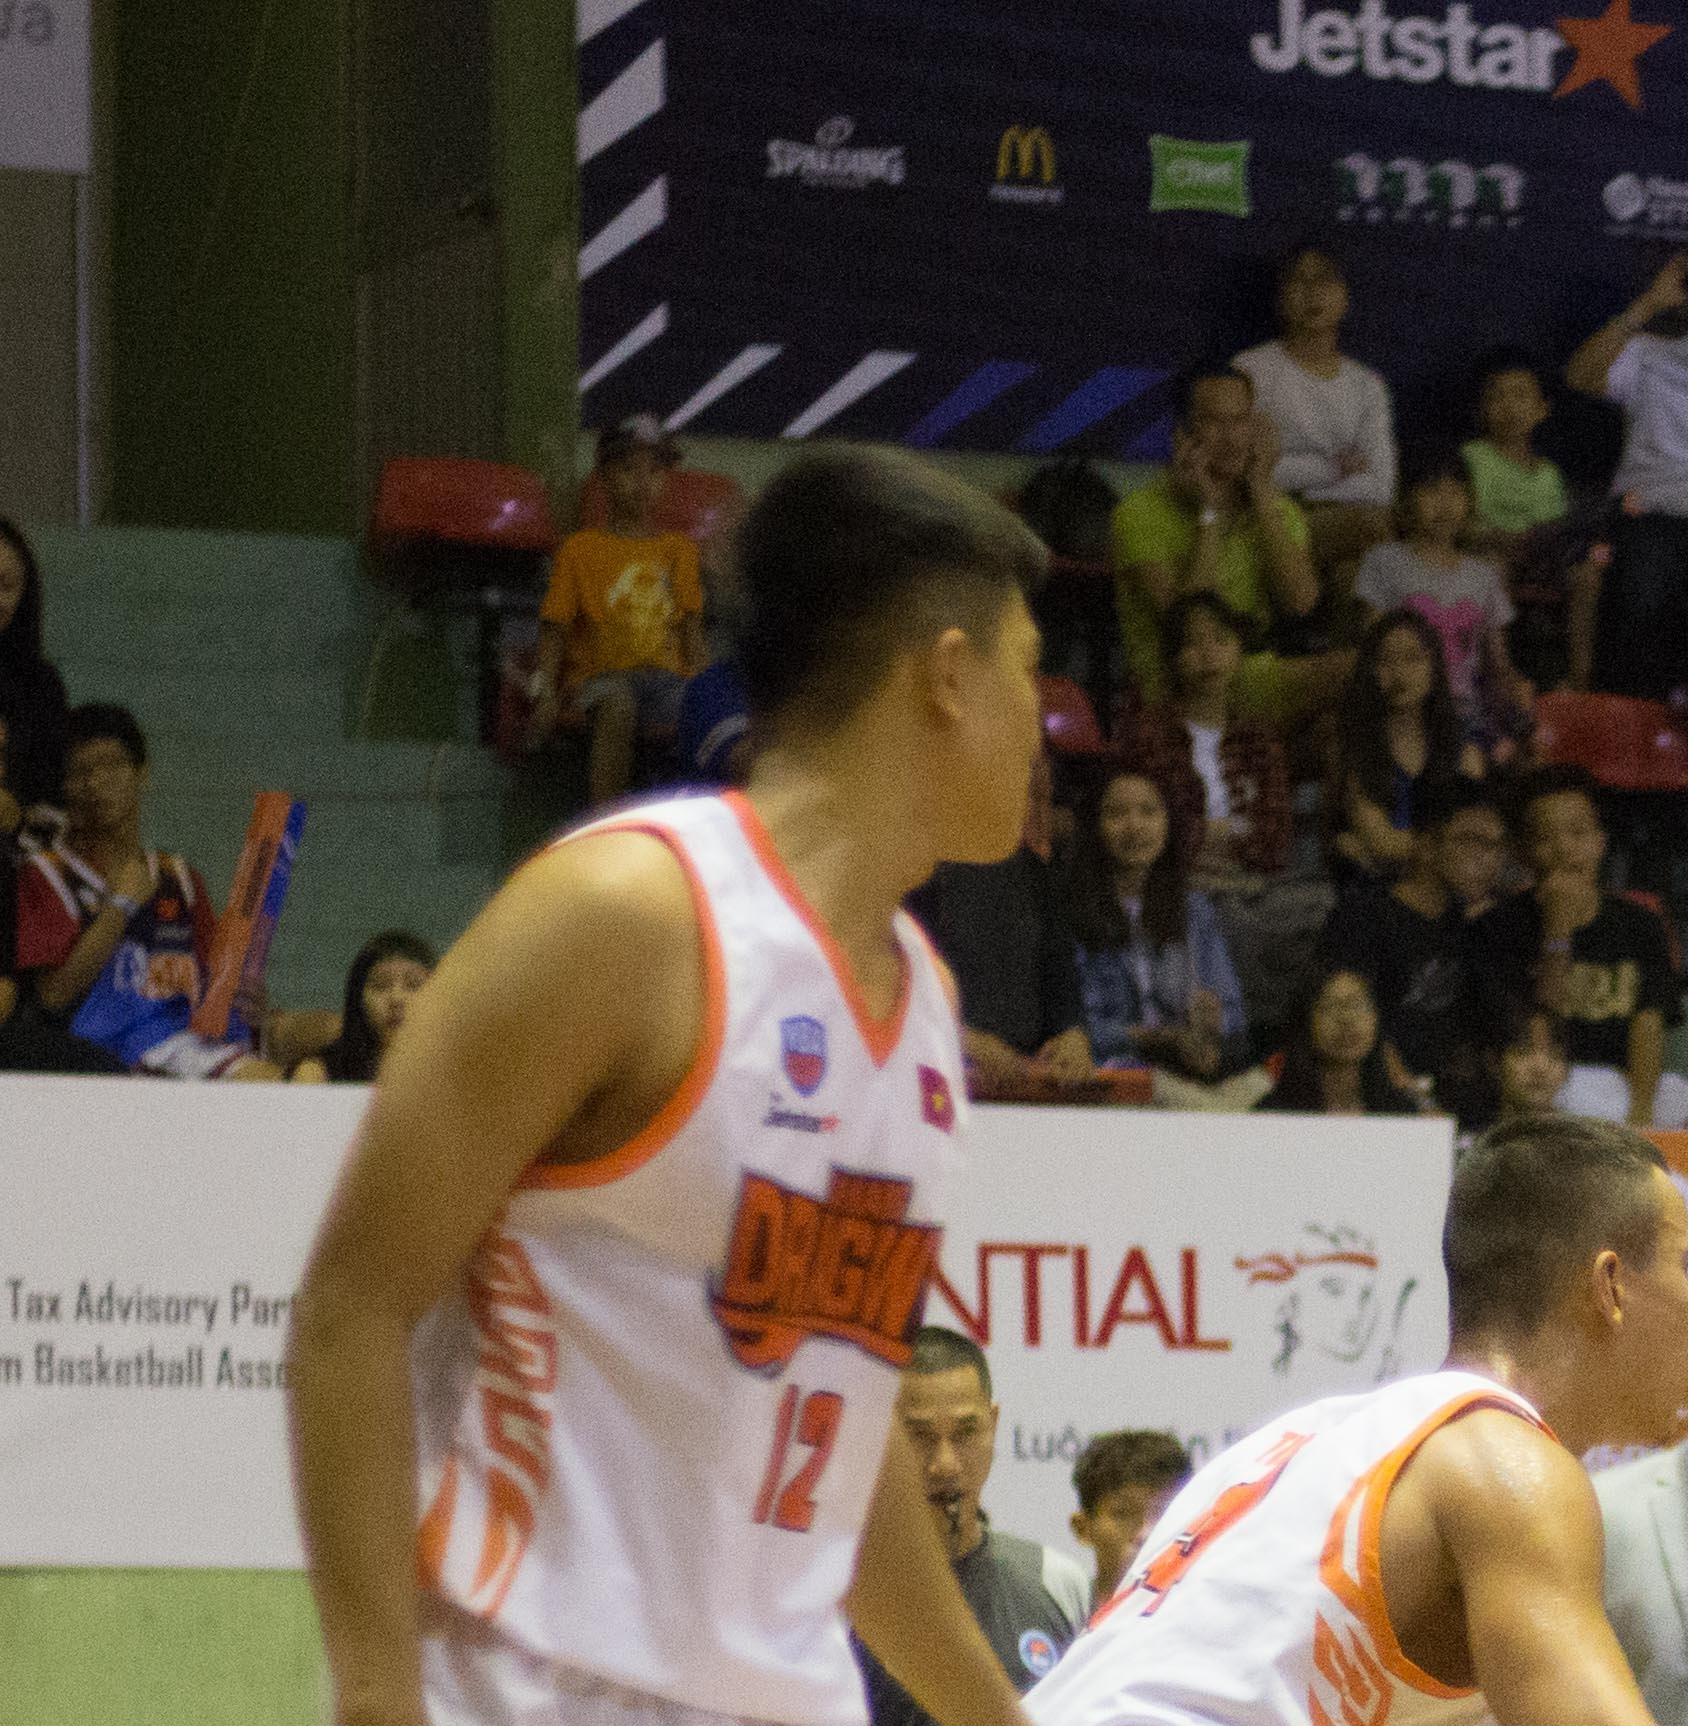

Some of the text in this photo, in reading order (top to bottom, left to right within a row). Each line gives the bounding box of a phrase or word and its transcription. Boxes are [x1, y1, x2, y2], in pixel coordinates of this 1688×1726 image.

[1250, 0, 1568, 93] Jetstar
[8, 1278, 62, 1323] Tax
[74, 1280, 219, 1336] Advisory
[34, 1342, 204, 1388] Basketball
[754, 1383, 845, 1533] 12
